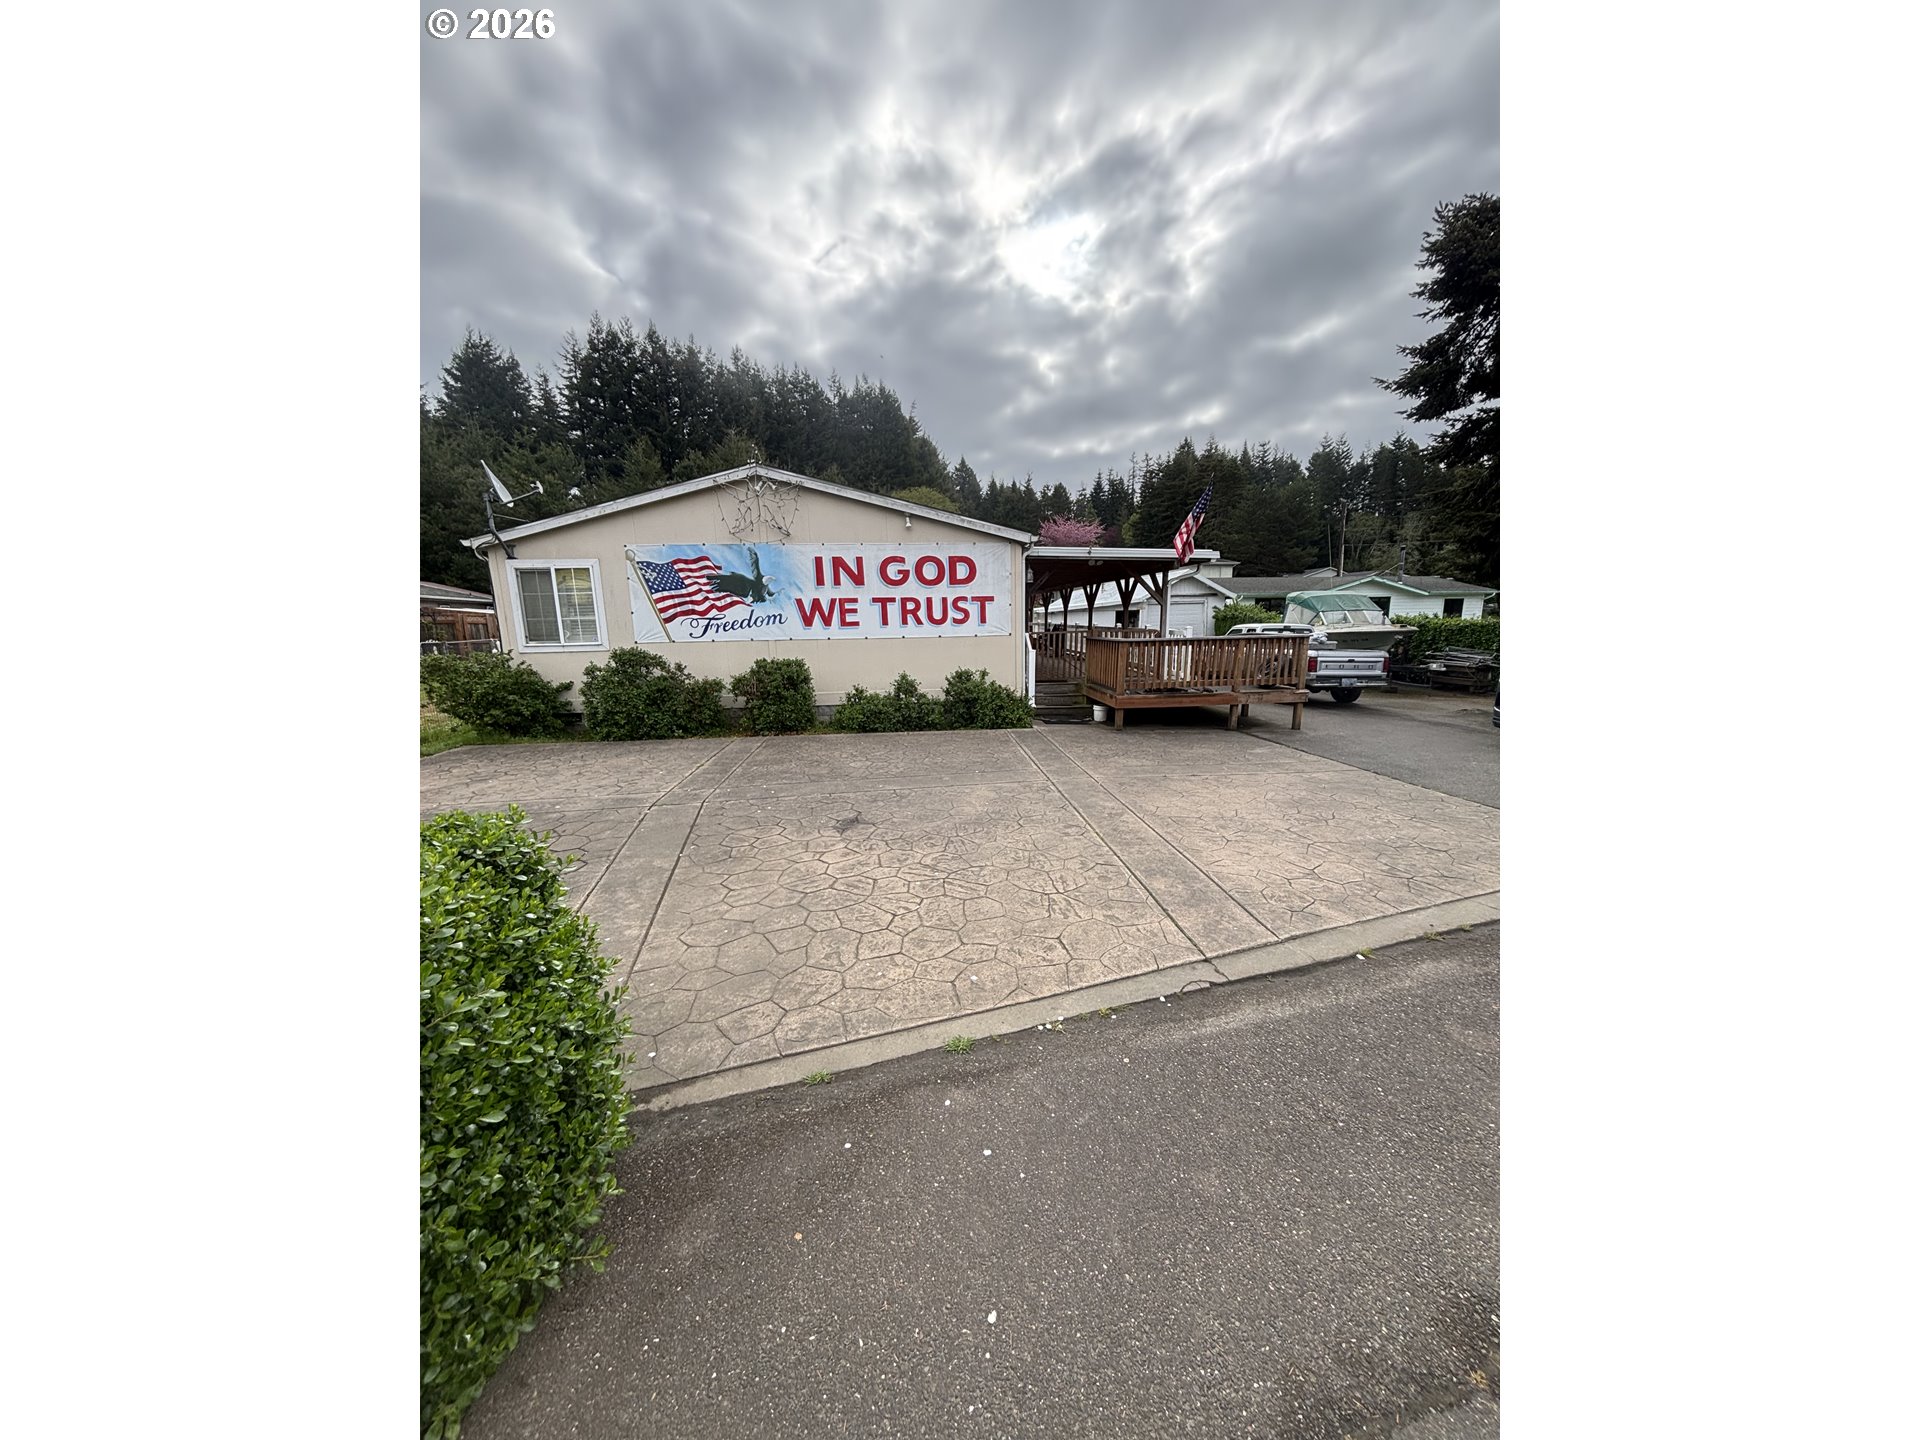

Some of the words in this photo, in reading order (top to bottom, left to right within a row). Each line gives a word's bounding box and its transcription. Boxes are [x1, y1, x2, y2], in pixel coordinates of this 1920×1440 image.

[814, 556, 865, 587] IN
[879, 555, 977, 587] GOD
[680, 609, 788, 639] Freedom
[794, 597, 860, 628] WE
[871, 595, 995, 627] TRUST
